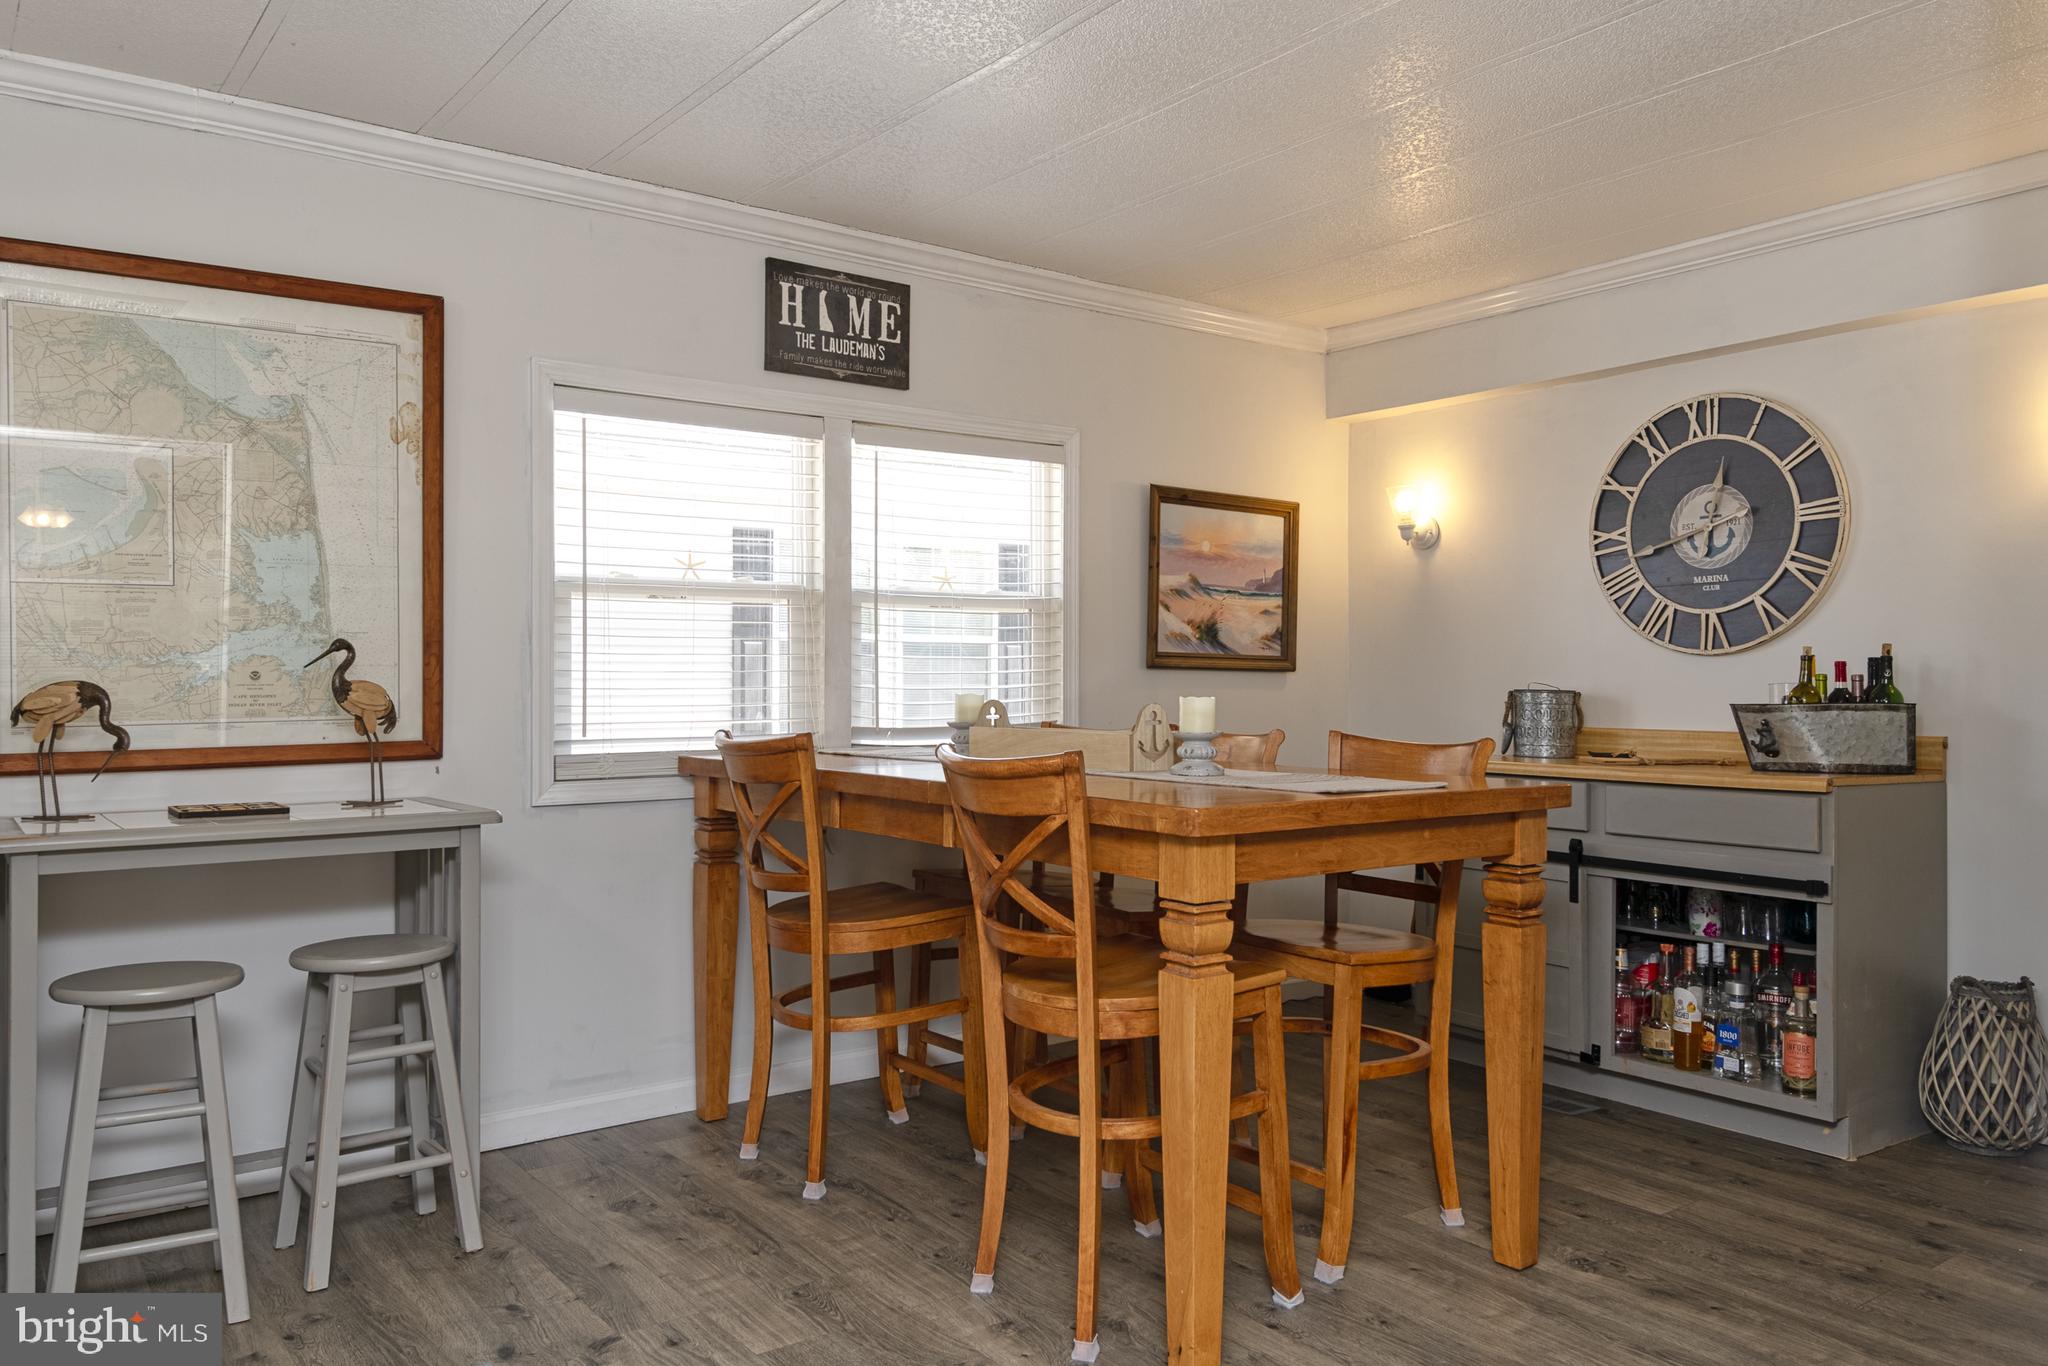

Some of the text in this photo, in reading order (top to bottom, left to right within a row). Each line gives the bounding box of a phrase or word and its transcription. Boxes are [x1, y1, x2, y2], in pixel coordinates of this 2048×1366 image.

[774, 272, 901, 304] Love makes the world go round
[795, 331, 886, 361] THE LAUDEMAN'S
[807, 355, 833, 367] makes
[835, 359, 847, 369] the
[849, 362, 864, 372] ride
[865, 364, 906, 378] worthwhile
[1693, 574, 1729, 584] MARINA
[1702, 584, 1721, 592] CLUB
[1757, 993, 1792, 1004] SMIRNOFF
[1719, 1029, 1738, 1041] 1800
